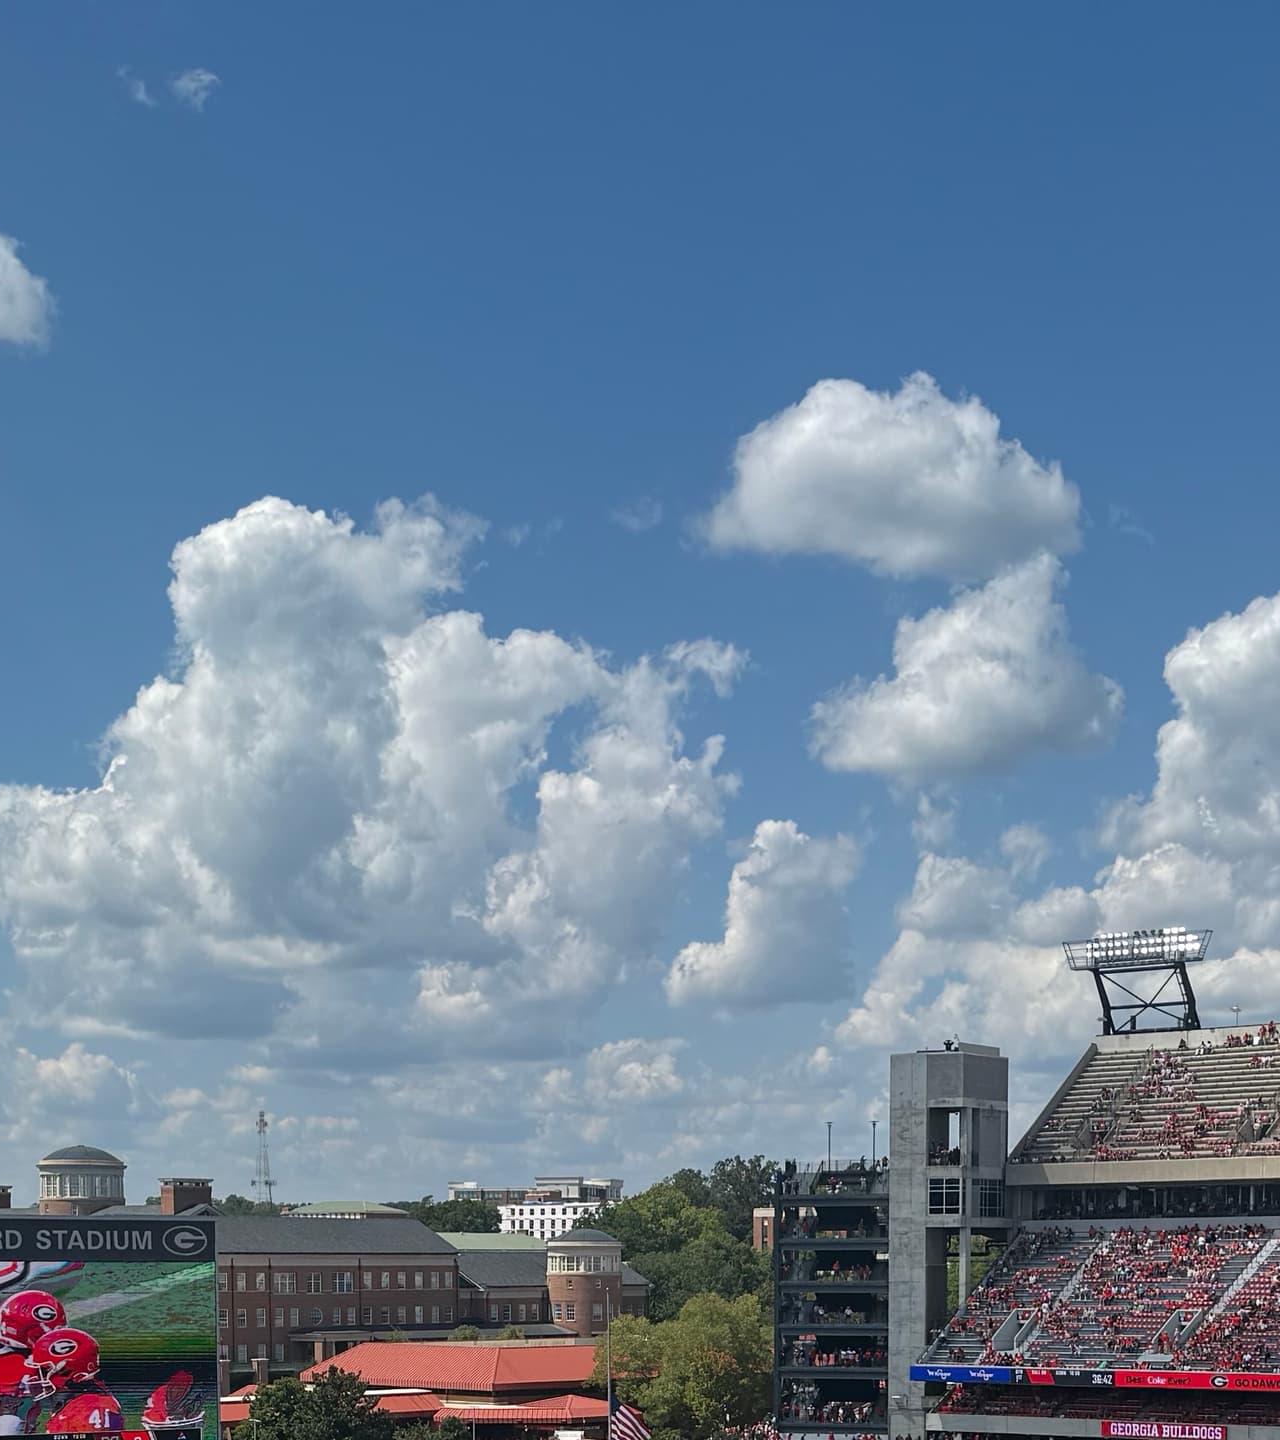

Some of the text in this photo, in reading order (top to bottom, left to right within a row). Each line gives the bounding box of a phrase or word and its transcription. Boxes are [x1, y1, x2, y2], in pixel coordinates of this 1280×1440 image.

[36, 1229, 153, 1251] STADIUM
[1147, 1375, 1166, 1385] Coke
[1234, 1378, 1249, 1388] GO
[88, 1408, 110, 1429] 41
[1110, 1422, 1222, 1440] GEORGIA BULLDOGS
